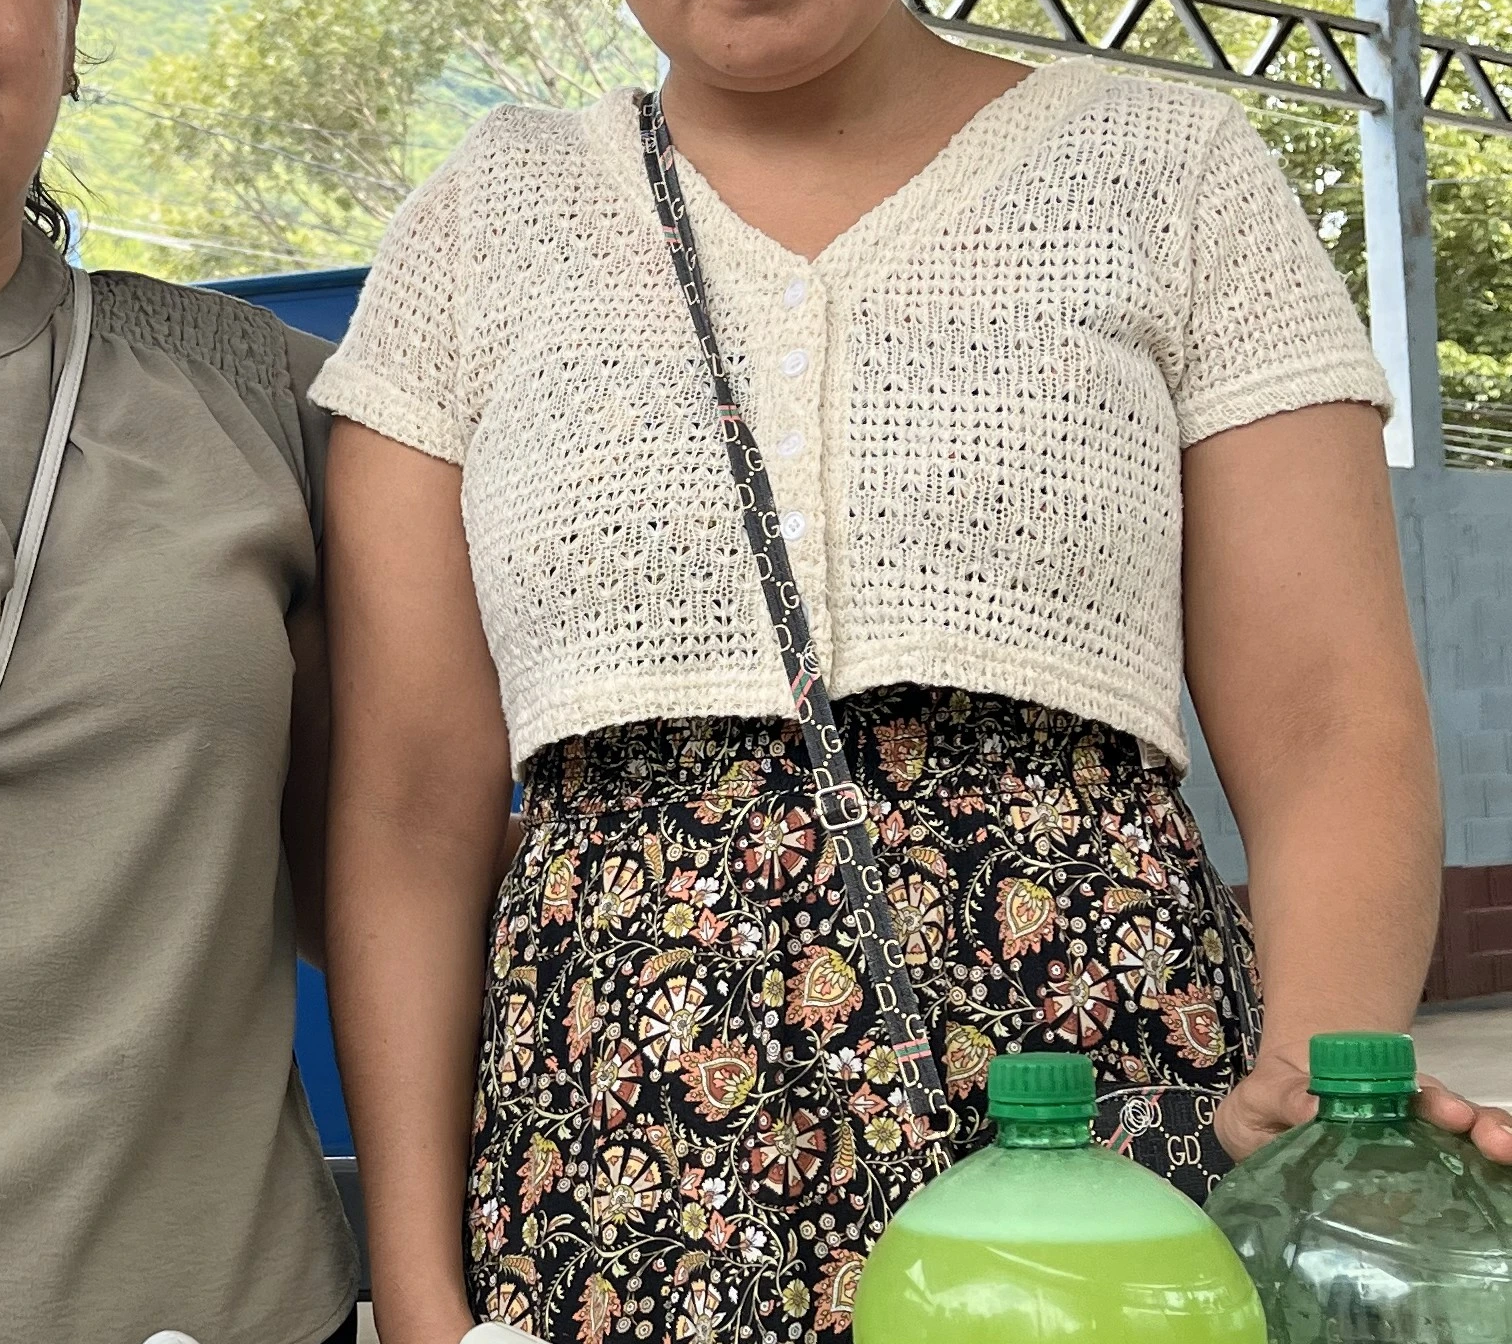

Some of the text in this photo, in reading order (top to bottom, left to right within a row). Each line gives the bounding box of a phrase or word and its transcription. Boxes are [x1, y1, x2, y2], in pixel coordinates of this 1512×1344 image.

[745, 447, 764, 472] G
[736, 484, 755, 509] D
[762, 511, 780, 539] G
[780, 581, 800, 609] G
[821, 725, 843, 754] G
[832, 835, 853, 864] D
[862, 865, 884, 894] G
[854, 909, 875, 938] D
[883, 939, 905, 969] G
[875, 983, 897, 1012] D
[1167, 1135, 1202, 1166] GD
